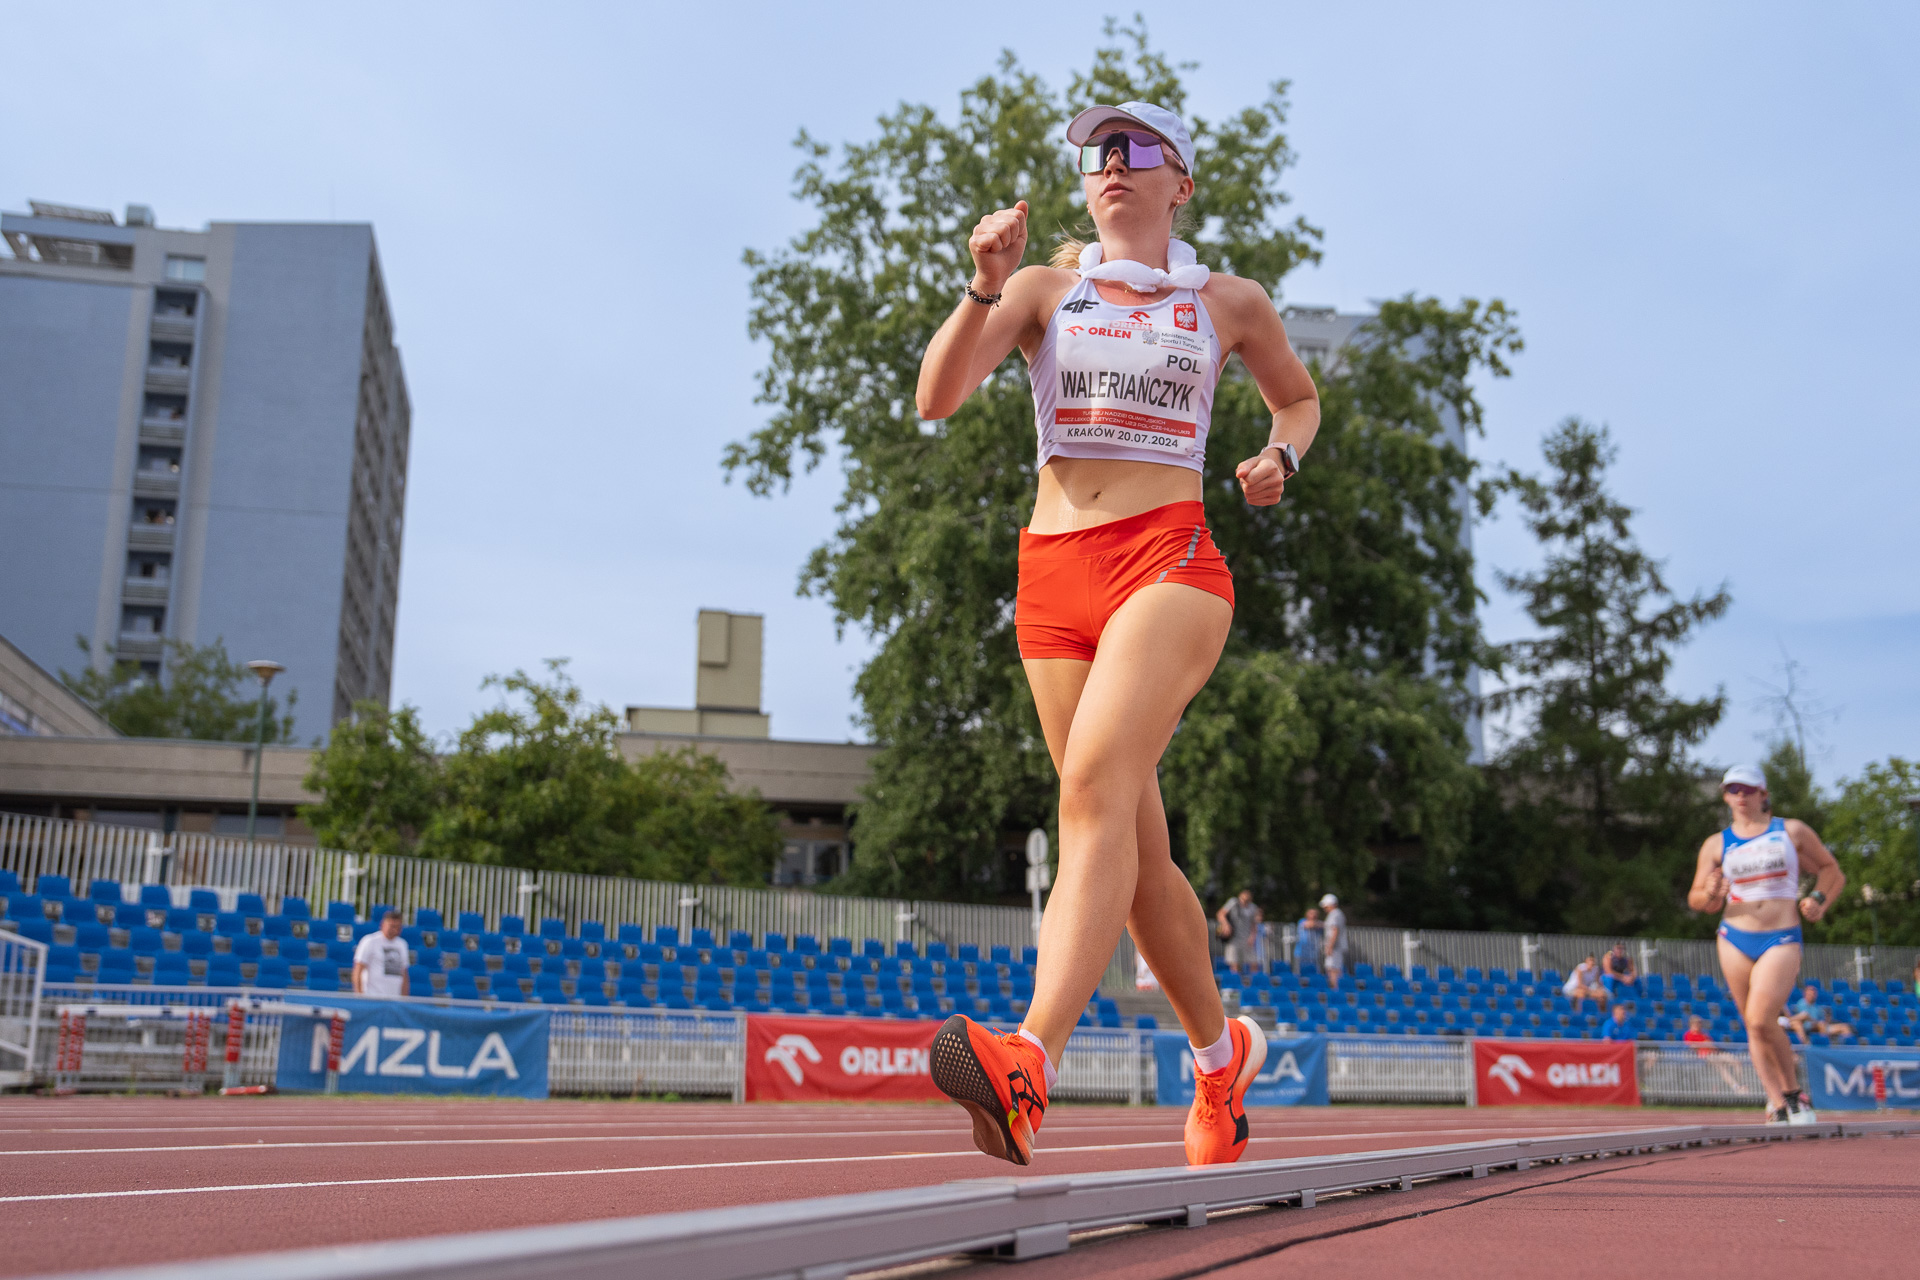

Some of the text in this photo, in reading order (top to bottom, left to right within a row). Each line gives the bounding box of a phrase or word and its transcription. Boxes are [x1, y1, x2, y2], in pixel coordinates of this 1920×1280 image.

[1088, 327, 1132, 339] ORLEN
[1166, 354, 1201, 374] POL
[1061, 369, 1195, 412] WALERIAŃCZYK
[1067, 425, 1179, 448] KRAKÓW 20.07.2024
[309, 1022, 520, 1079] MZLA
[840, 1046, 929, 1076] ORLEN
[1547, 1063, 1620, 1087] ORLEN
